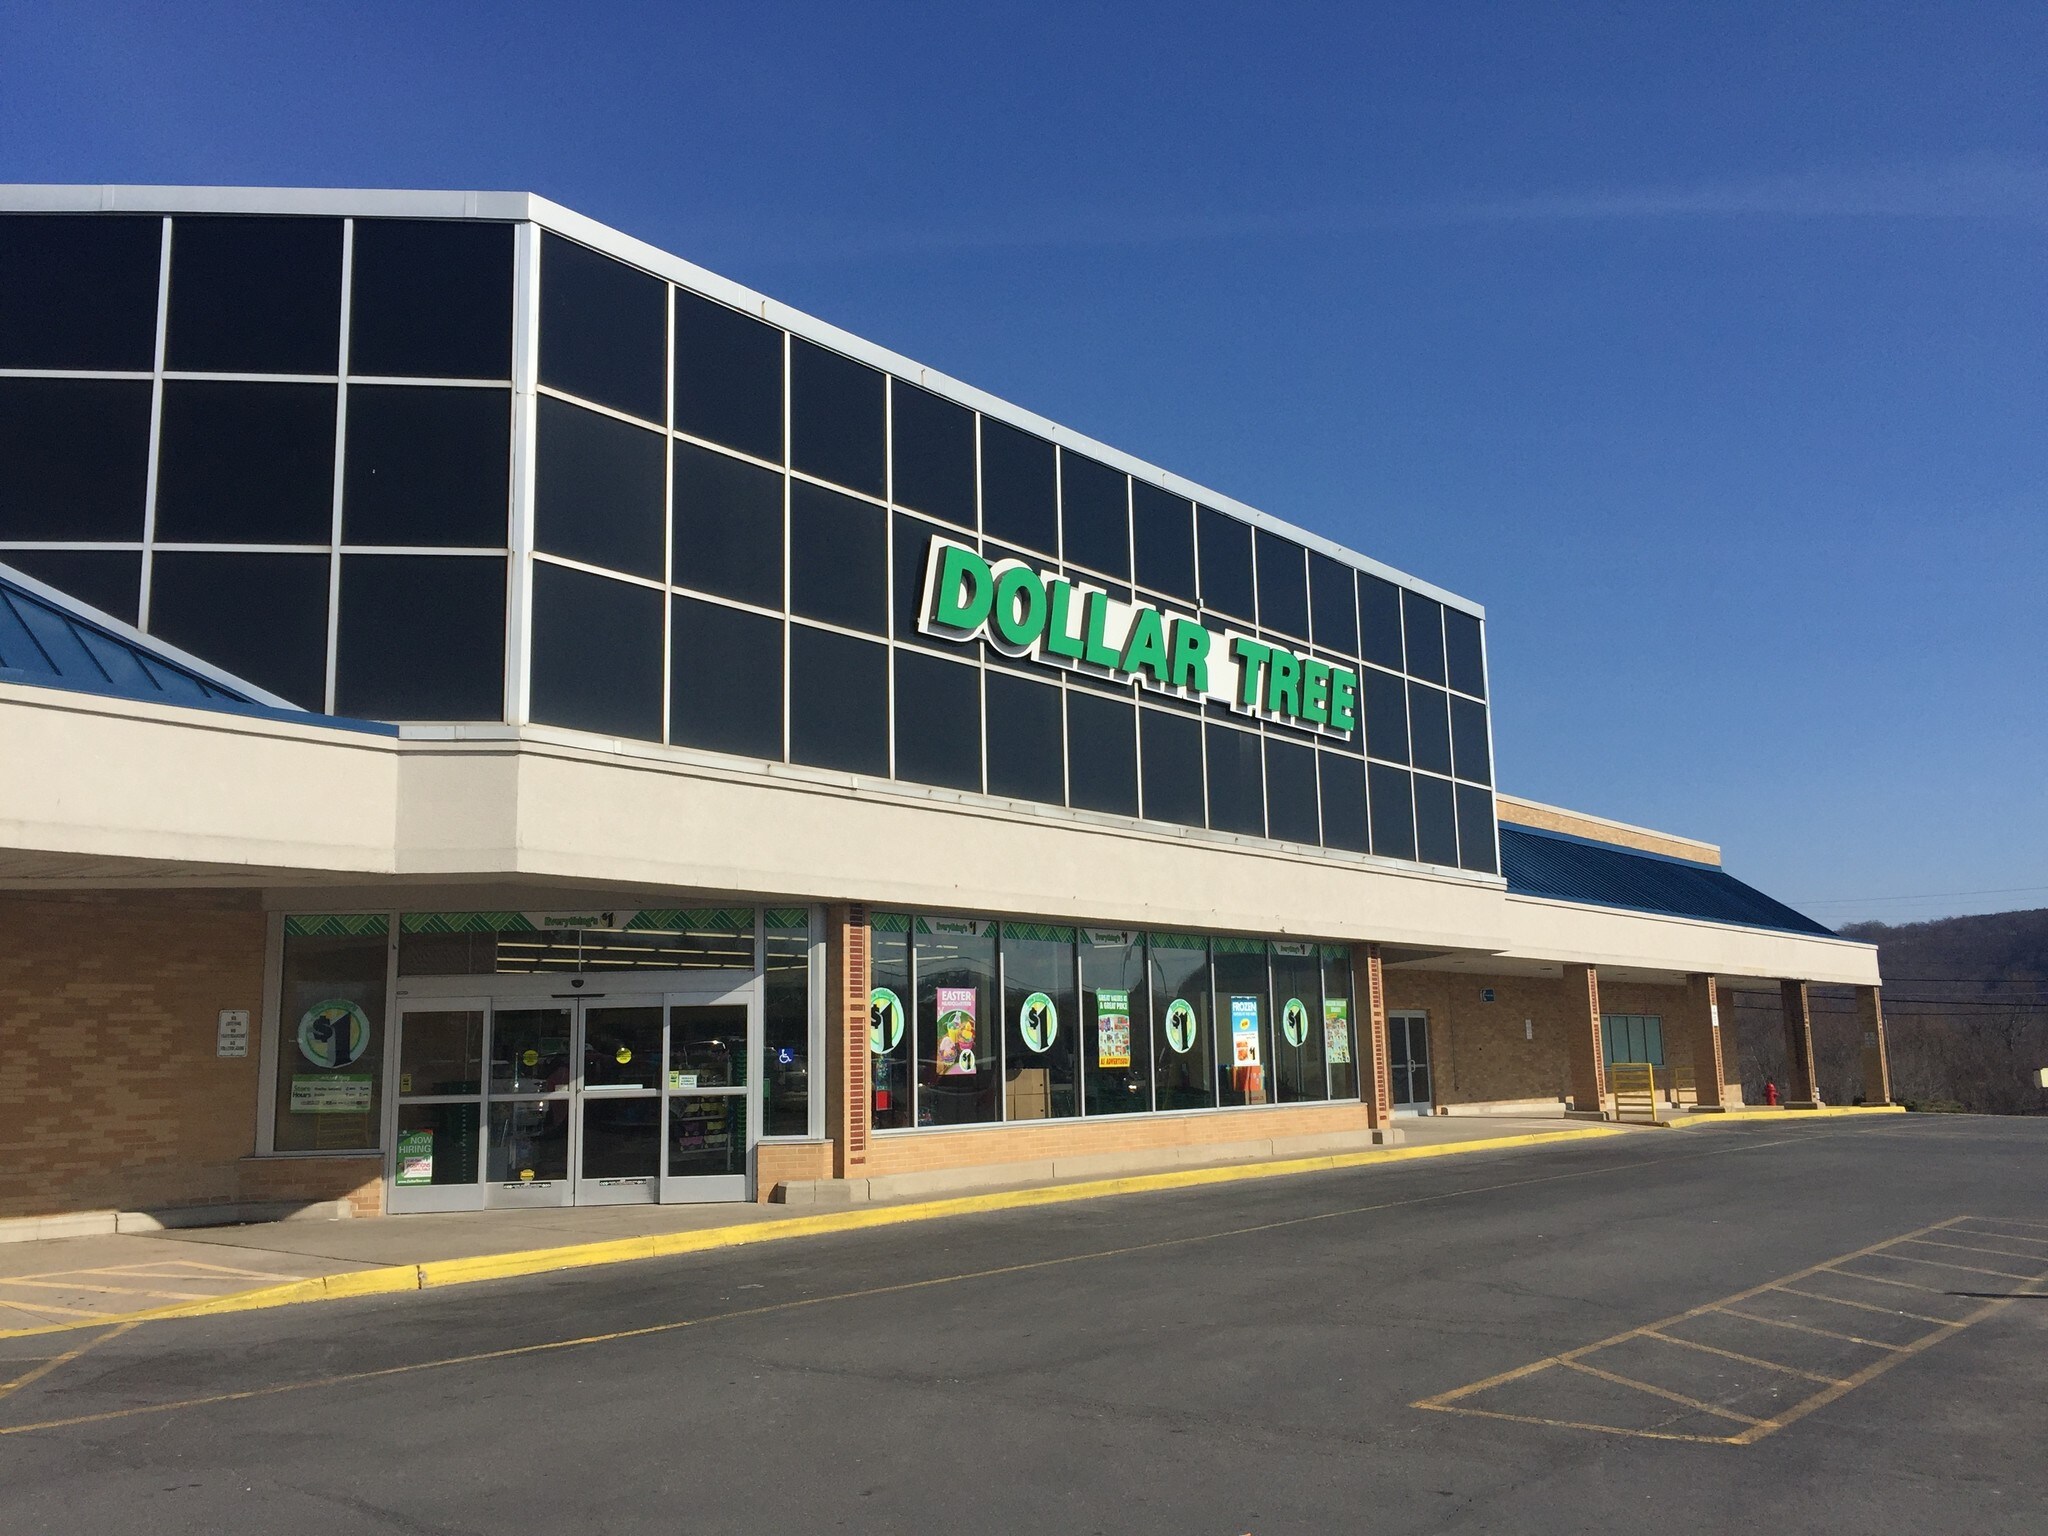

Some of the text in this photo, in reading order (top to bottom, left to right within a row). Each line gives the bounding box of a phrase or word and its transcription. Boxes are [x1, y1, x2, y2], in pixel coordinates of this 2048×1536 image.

[933, 545, 1358, 732] DOLLAR TREE
[941, 990, 971, 1001] EASTER
[1232, 1002, 1257, 1012] FROZEN
[313, 1011, 353, 1067] $1
[1028, 1004, 1049, 1050] $1
[1172, 1011, 1189, 1051] $1
[1287, 1009, 1303, 1045] $1
[399, 1145, 431, 1154] HIRING
[410, 1136, 432, 1145] NOW
